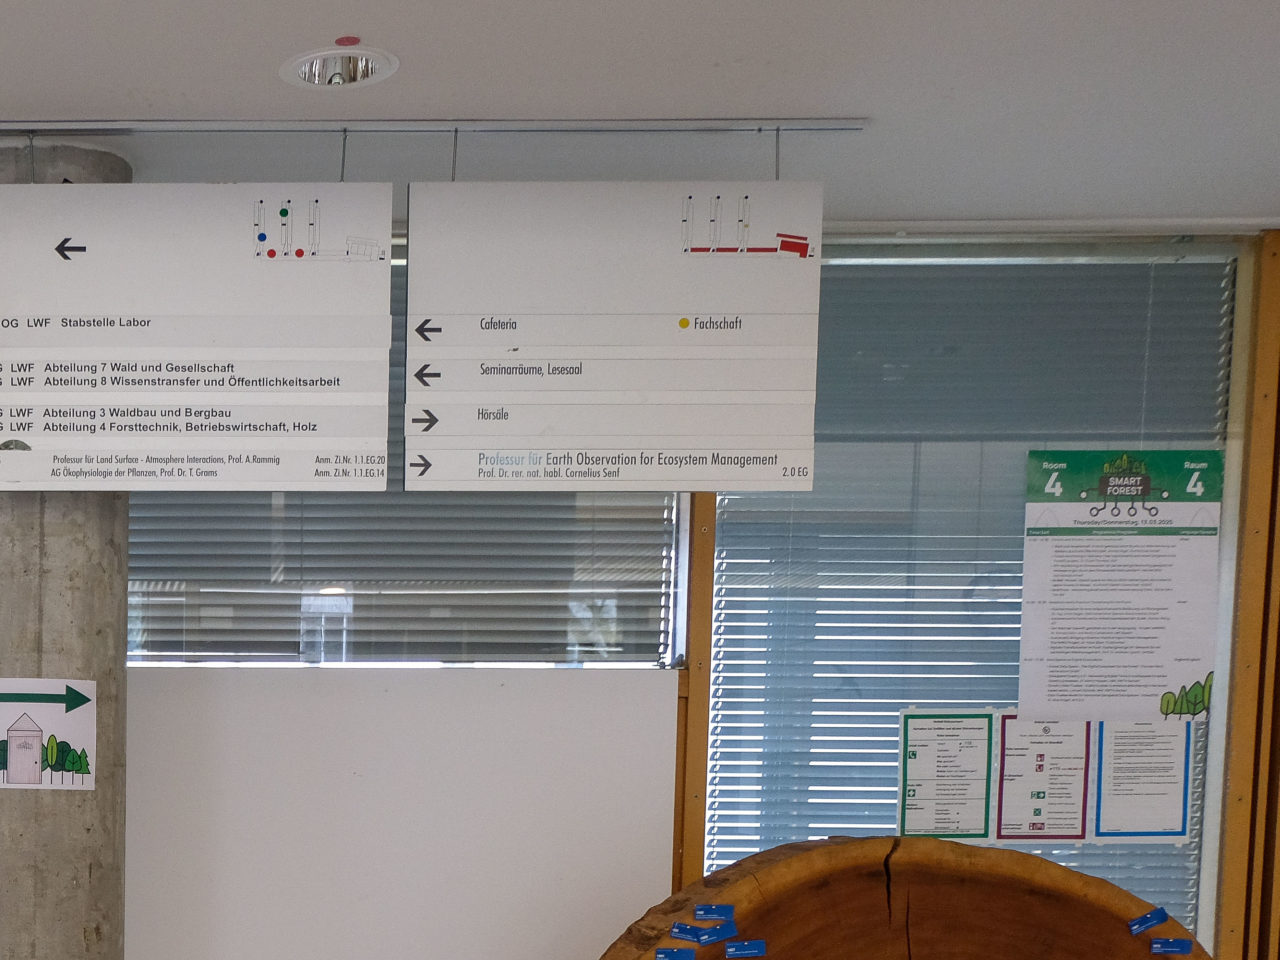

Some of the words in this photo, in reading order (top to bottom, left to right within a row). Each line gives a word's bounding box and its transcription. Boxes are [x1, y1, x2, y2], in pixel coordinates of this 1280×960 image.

[1, 318, 19, 328] OG
[27, 318, 51, 327] LWF
[61, 318, 115, 327] Stabstelle
[119, 318, 151, 327] Labor
[480, 317, 517, 330] Cafeteria
[694, 316, 742, 329] Fachschaft
[11, 363, 35, 372] LWF
[44, 363, 97, 374] Abteilung
[101, 363, 107, 372] 7
[110, 363, 137, 372] Wald
[141, 363, 162, 372] und
[165, 363, 234, 372] Gesellschaft
[480, 363, 544, 376] Seminarräume,
[547, 362, 582, 375] Lesesaal
[11, 377, 35, 386] LWF
[44, 377, 97, 388] Abteilung
[101, 376, 107, 386] 8
[110, 376, 201, 386] Wissenstransfer
[204, 377, 225, 386] und
[228, 376, 340, 386] Öffentlichkeitsarbeit
[10, 408, 33, 418] LWF
[43, 408, 96, 420] Abteilung
[100, 408, 106, 417] 3
[109, 408, 156, 417] Waldbau
[160, 408, 181, 417] und
[185, 408, 231, 420] Bergbau
[478, 408, 509, 420] Hörsäle
[10, 422, 34, 431] LWF
[43, 422, 96, 434] Abteilung
[100, 422, 106, 431] 4
[110, 422, 182, 432] Forsttechnik,
[186, 422, 289, 432] Betriebswirtschaft,
[293, 422, 317, 431] Holz
[478, 452, 525, 465] Professur
[528, 452, 542, 465] für
[546, 452, 572, 465] Earth
[576, 452, 636, 465] Observation
[640, 452, 654, 465] for
[658, 452, 707, 468] Ecosystem
[711, 453, 778, 468] Management
[478, 468, 496, 478] Prof.
[498, 468, 509, 478] Dr.
[526, 469, 541, 478] nat.
[543, 467, 563, 478] habl.
[565, 468, 601, 478] Cornelius
[602, 467, 620, 478] Senf
[782, 467, 796, 477] 2.0
[798, 467, 808, 477] EG
[1044, 472, 1062, 496] 4
[1108, 477, 1142, 486] SMART
[1186, 472, 1204, 496] 4
[1107, 486, 1143, 495] FOREST
